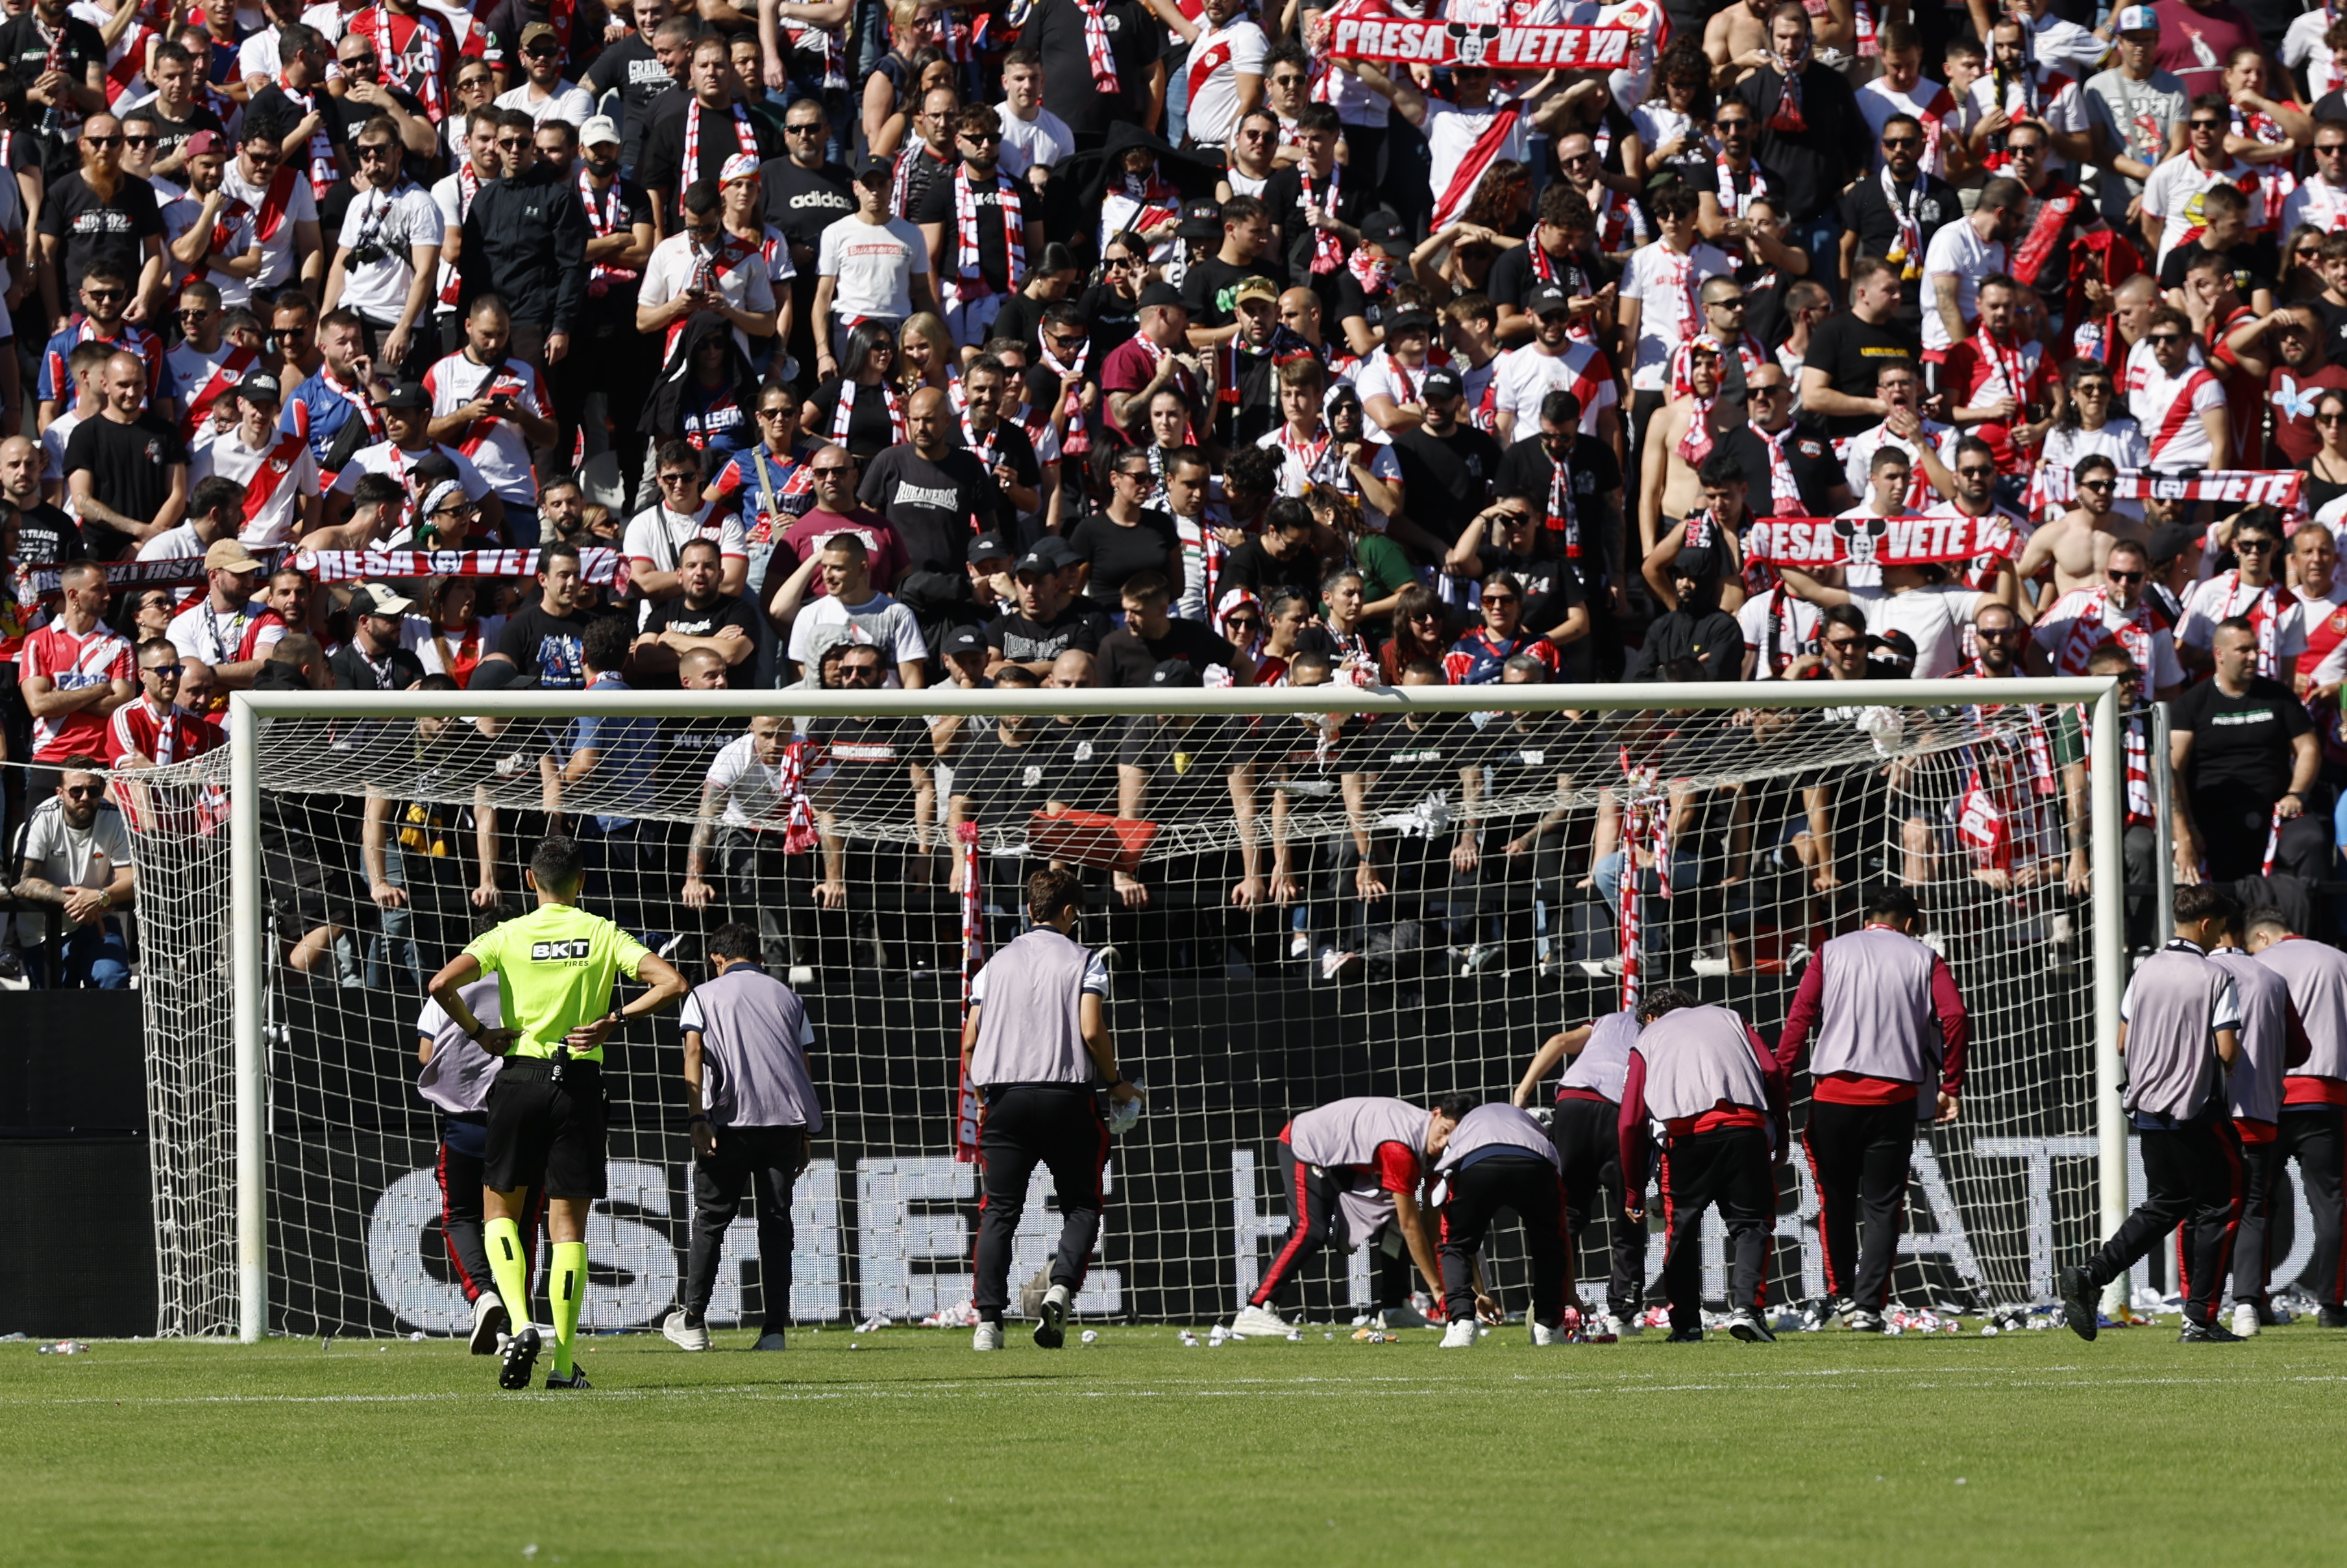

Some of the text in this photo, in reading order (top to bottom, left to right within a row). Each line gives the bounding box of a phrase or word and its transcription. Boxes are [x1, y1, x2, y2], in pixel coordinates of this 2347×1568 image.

[1334, 19, 1628, 64] PRESA VETE YA
[789, 191, 853, 210] adidas
[850, 245, 900, 256] Bukaneros
[895, 480, 958, 509] BUKANEROS
[2199, 470, 2295, 504] VETE
[1888, 518, 1970, 558] VETE
[477, 548, 543, 575] VET
[532, 940, 589, 959] BKT
